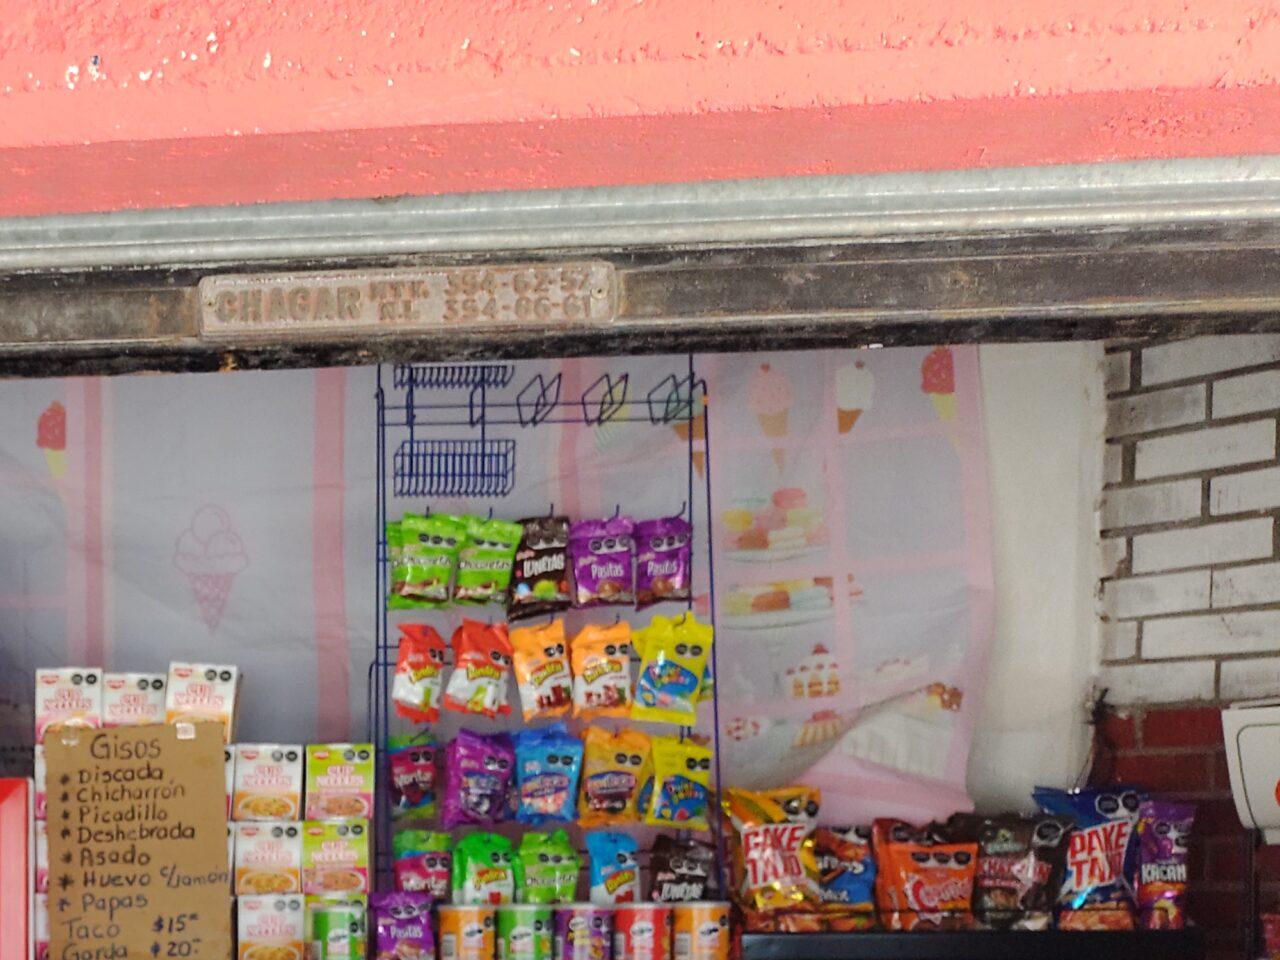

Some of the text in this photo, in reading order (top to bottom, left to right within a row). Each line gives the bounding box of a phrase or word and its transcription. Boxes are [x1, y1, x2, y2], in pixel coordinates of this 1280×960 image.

[216, 286, 362, 323] CHAGAR
[524, 554, 565, 578] LUNETAS
[591, 563, 624, 579] Pasitas
[647, 561, 677, 577] Pasitas
[90, 734, 161, 760] Gisos
[79, 764, 164, 784] Discada
[77, 780, 186, 803] Chicharrón
[80, 803, 168, 823] Picadillo
[78, 822, 196, 844] Deshebrada
[1071, 822, 1126, 858] PAKE
[80, 845, 151, 867] Asado
[83, 871, 151, 888] Huevo
[82, 893, 148, 921] Papas
[62, 917, 121, 939] Taco
